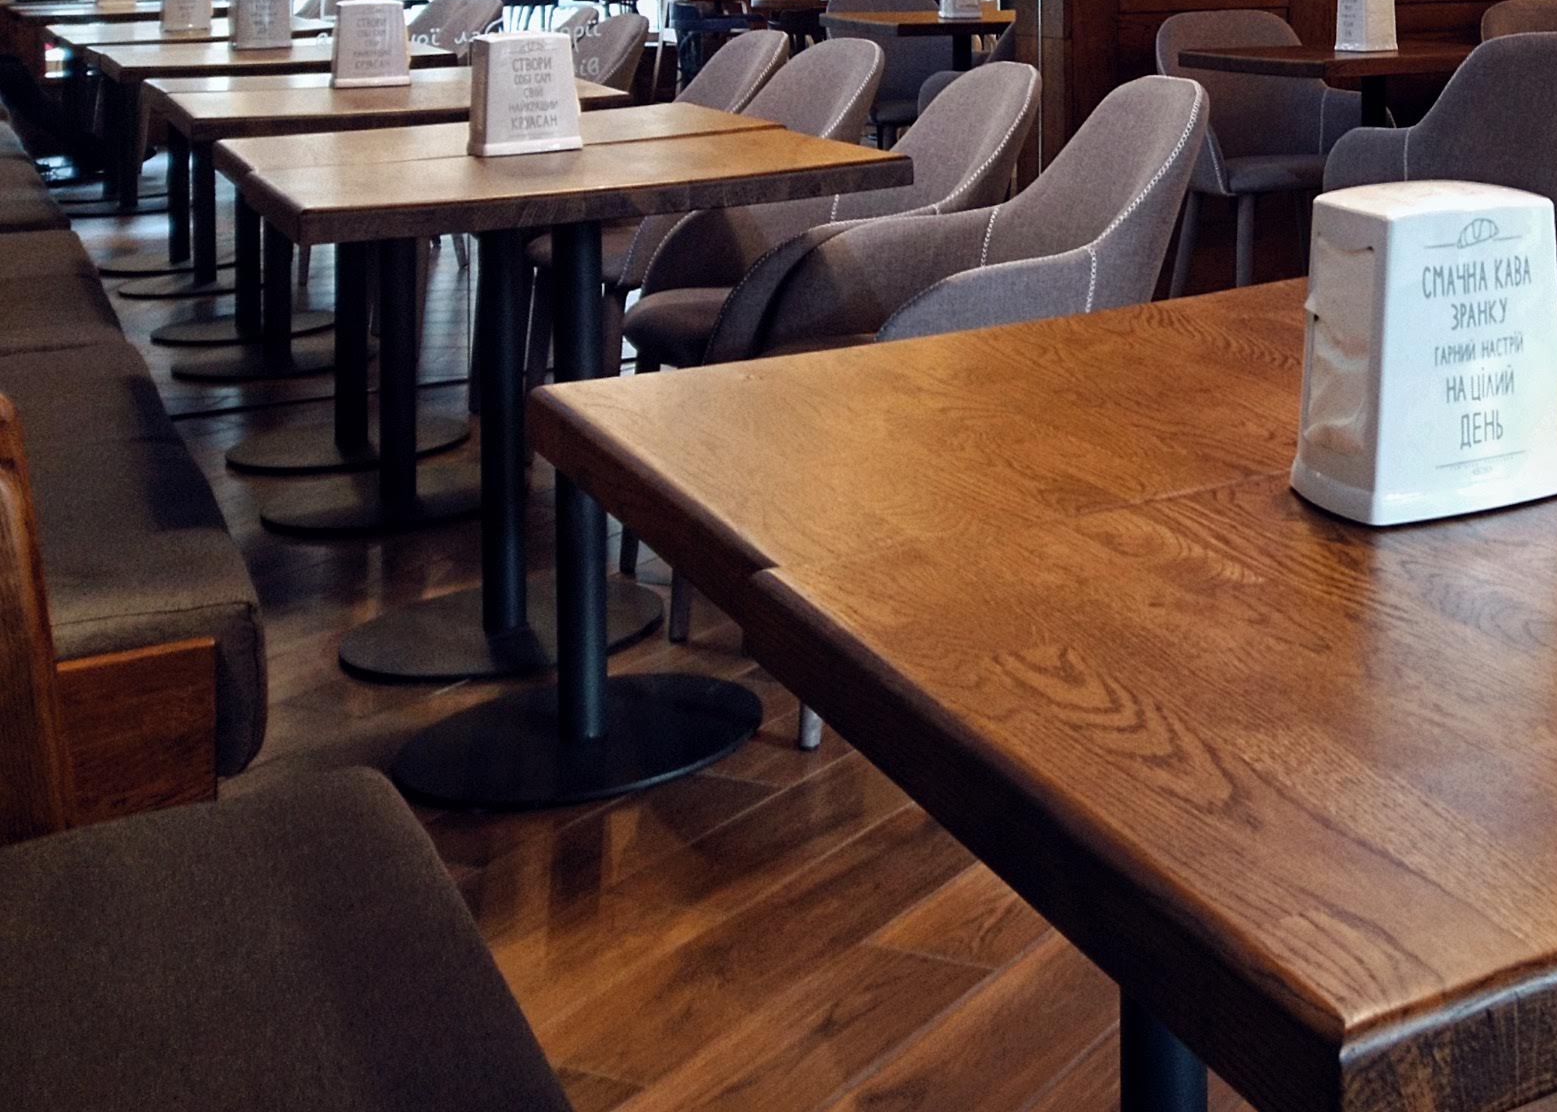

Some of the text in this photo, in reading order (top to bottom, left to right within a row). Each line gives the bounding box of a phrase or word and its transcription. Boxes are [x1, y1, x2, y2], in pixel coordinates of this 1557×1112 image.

[511, 56, 552, 72] СТВОРИ
[511, 115, 558, 131] КРУАСАН
[1422, 255, 1532, 300] СМАЧНА КАВА
[1450, 297, 1508, 330] ЗРАНКУ
[1434, 338, 1476, 367] ГАРНИЙ
[1446, 375, 1466, 404] НА
[1460, 408, 1504, 450] ДЕНЬ
